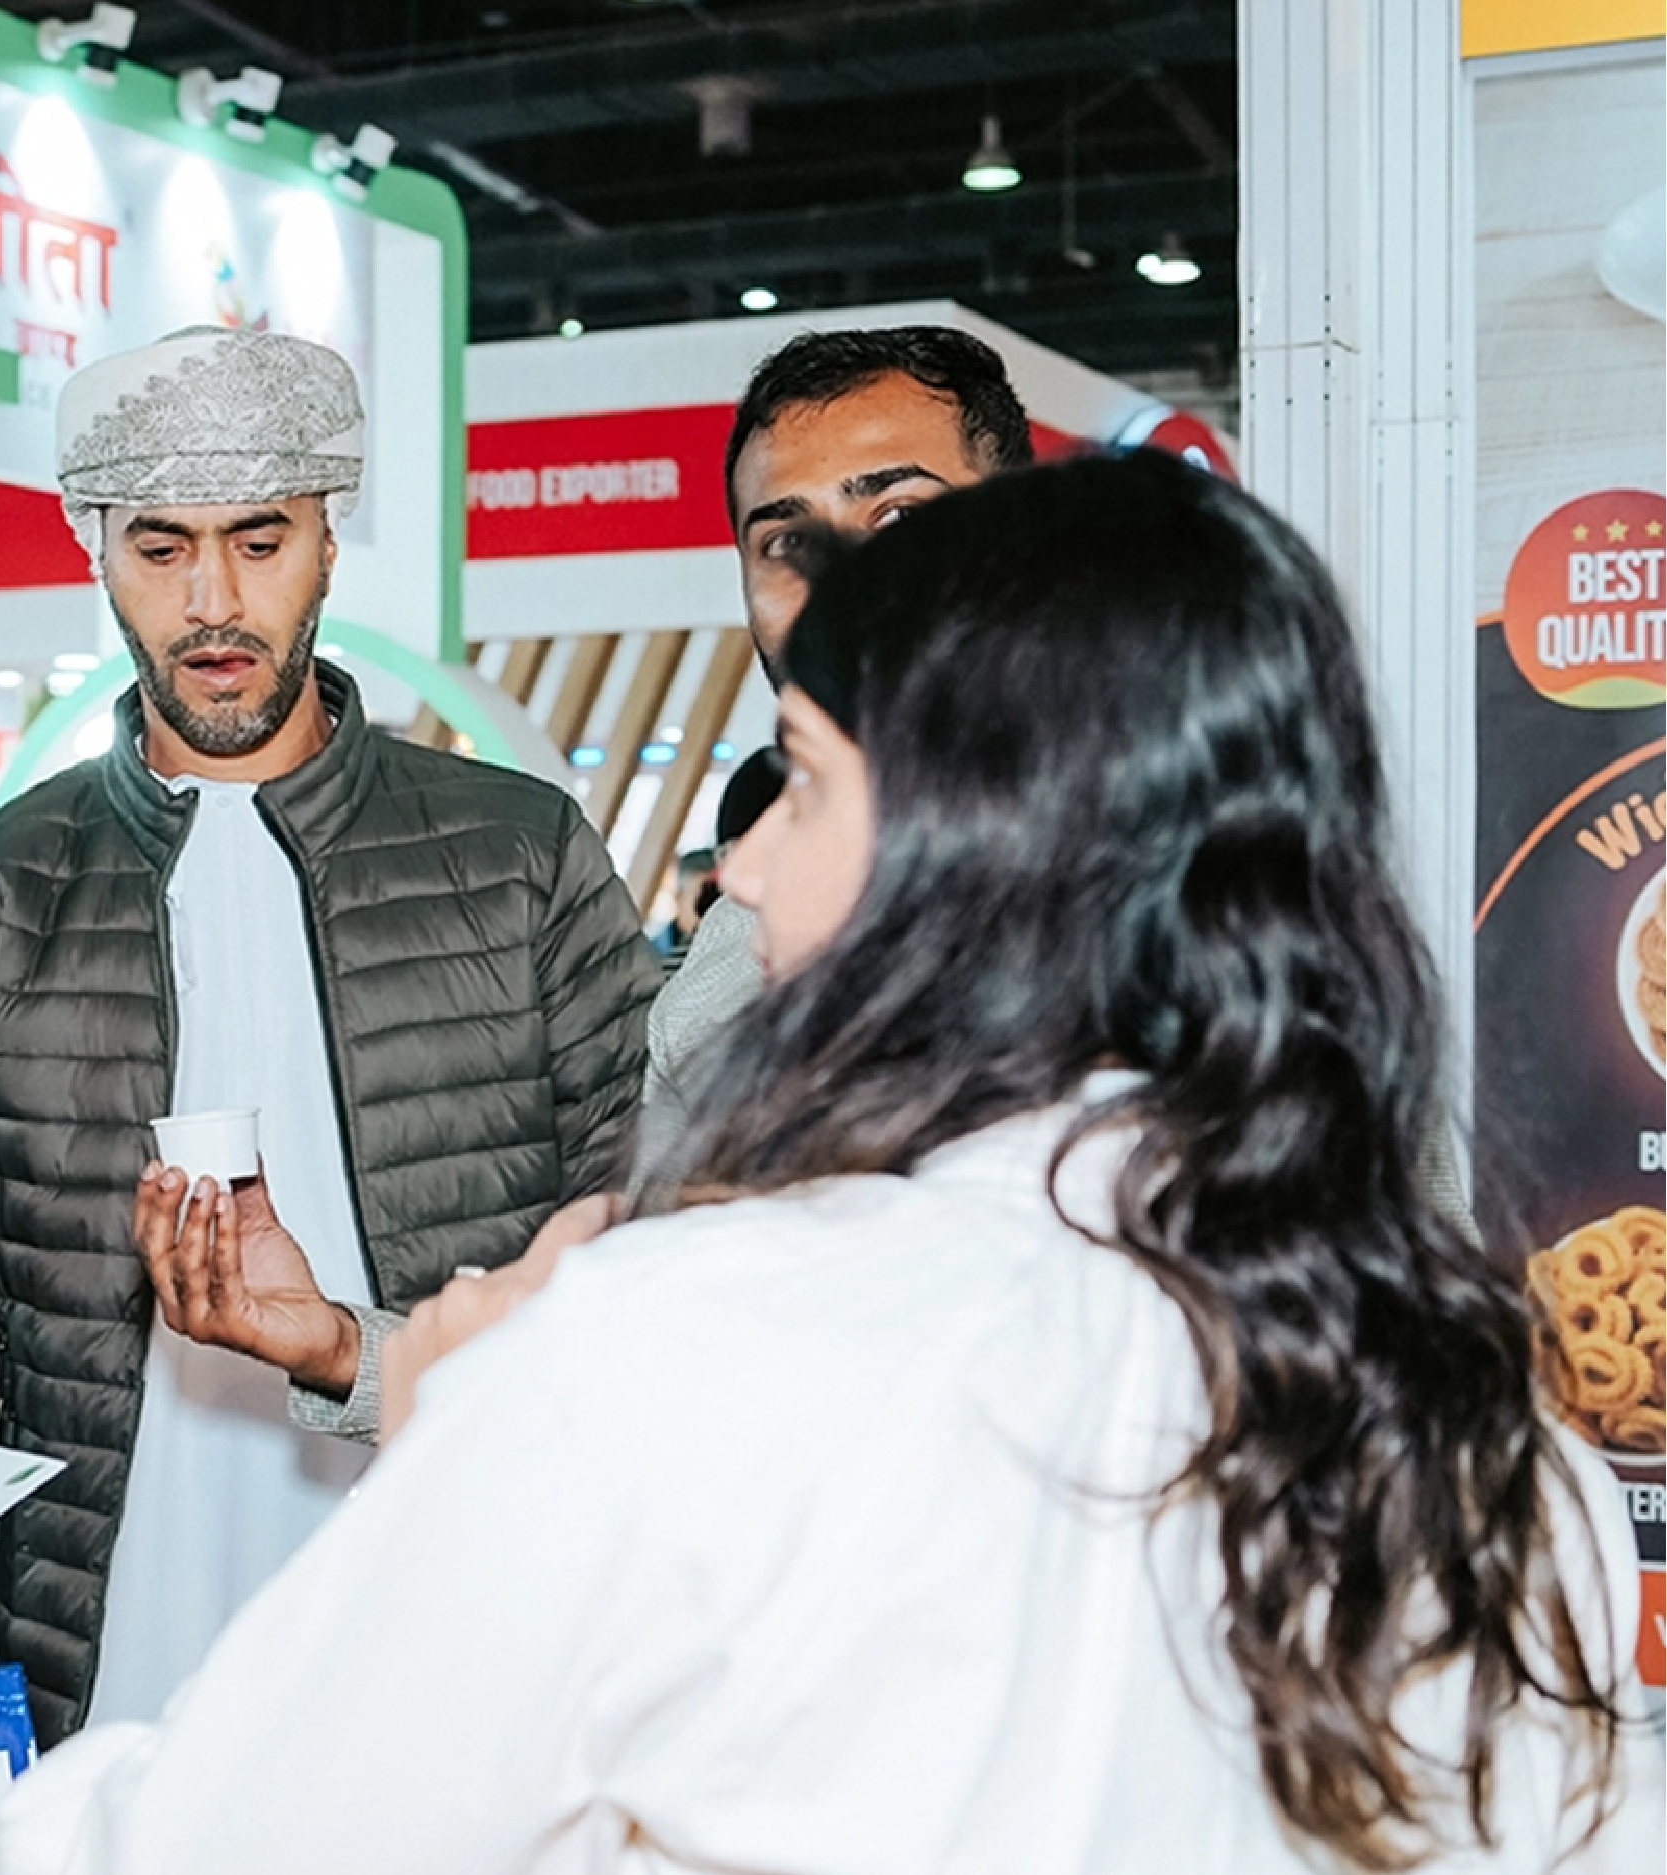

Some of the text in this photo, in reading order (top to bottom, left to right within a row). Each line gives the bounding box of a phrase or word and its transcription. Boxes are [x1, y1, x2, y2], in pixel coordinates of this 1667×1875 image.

[465, 457, 679, 511] FOOD EXPORTER
[1568, 549, 1665, 603] BEST
